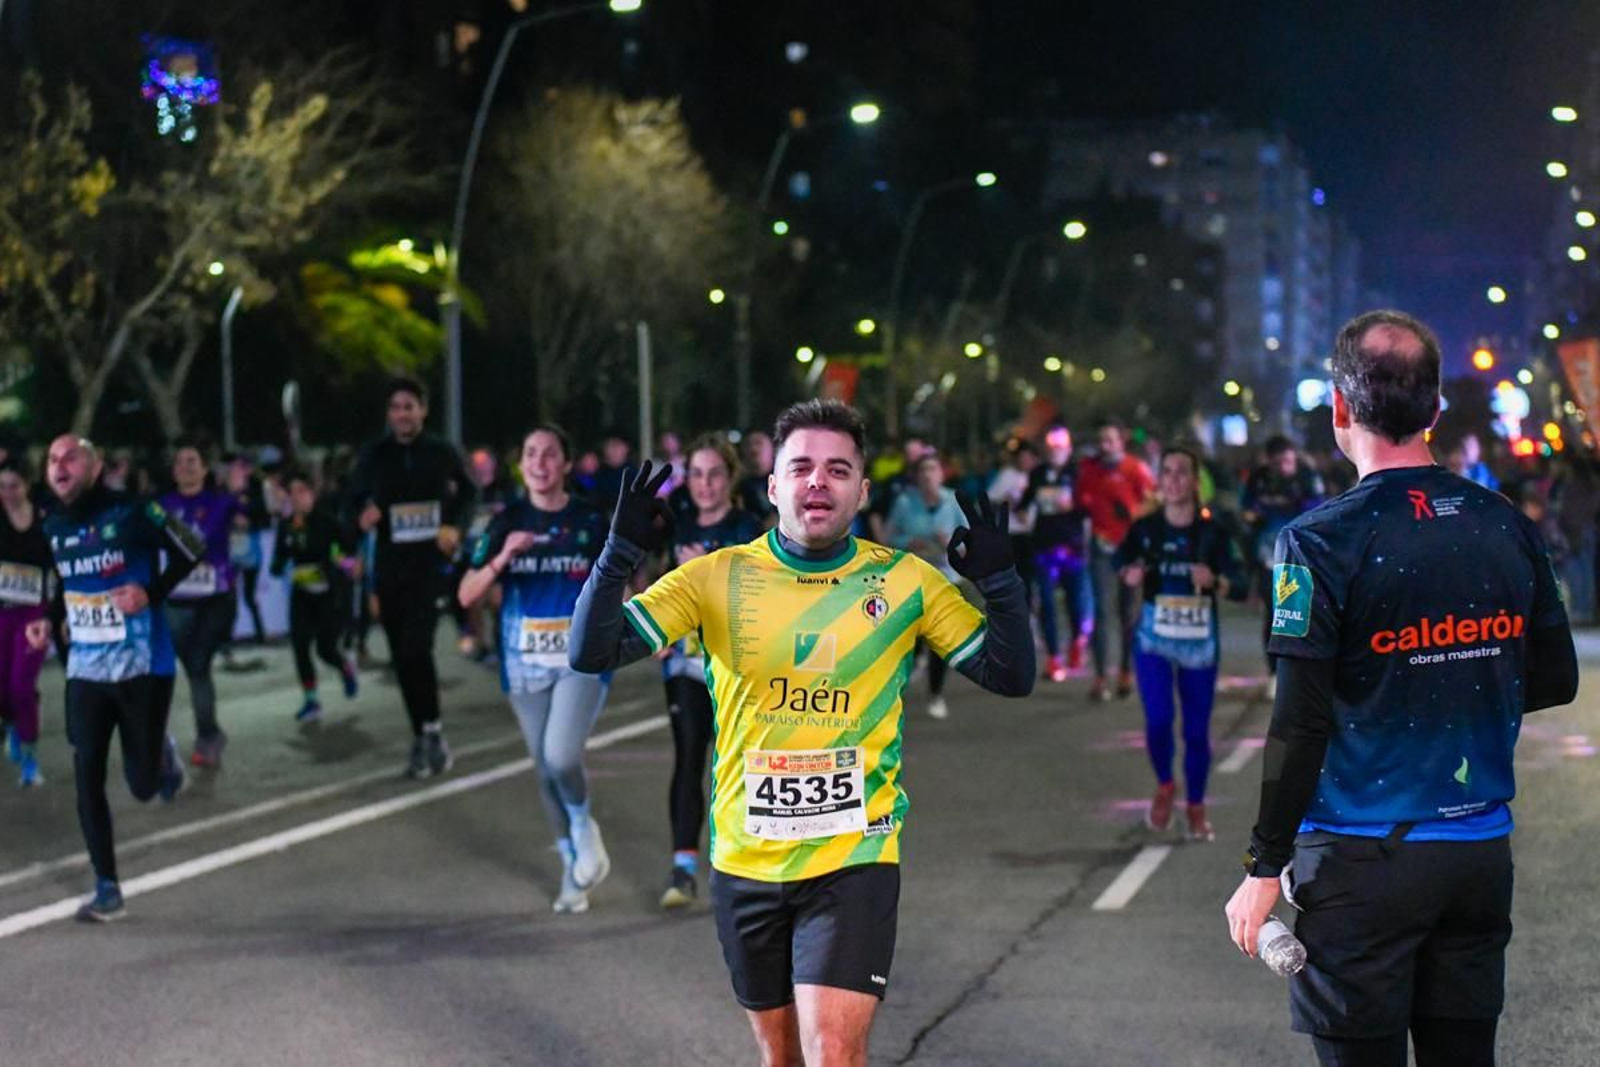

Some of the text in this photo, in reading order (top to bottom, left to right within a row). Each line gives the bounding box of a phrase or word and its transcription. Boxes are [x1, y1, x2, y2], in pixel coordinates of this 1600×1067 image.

[1409, 645, 1501, 665] obras maestras
[769, 677, 850, 714] Jaén
[756, 772, 853, 807] 4535
